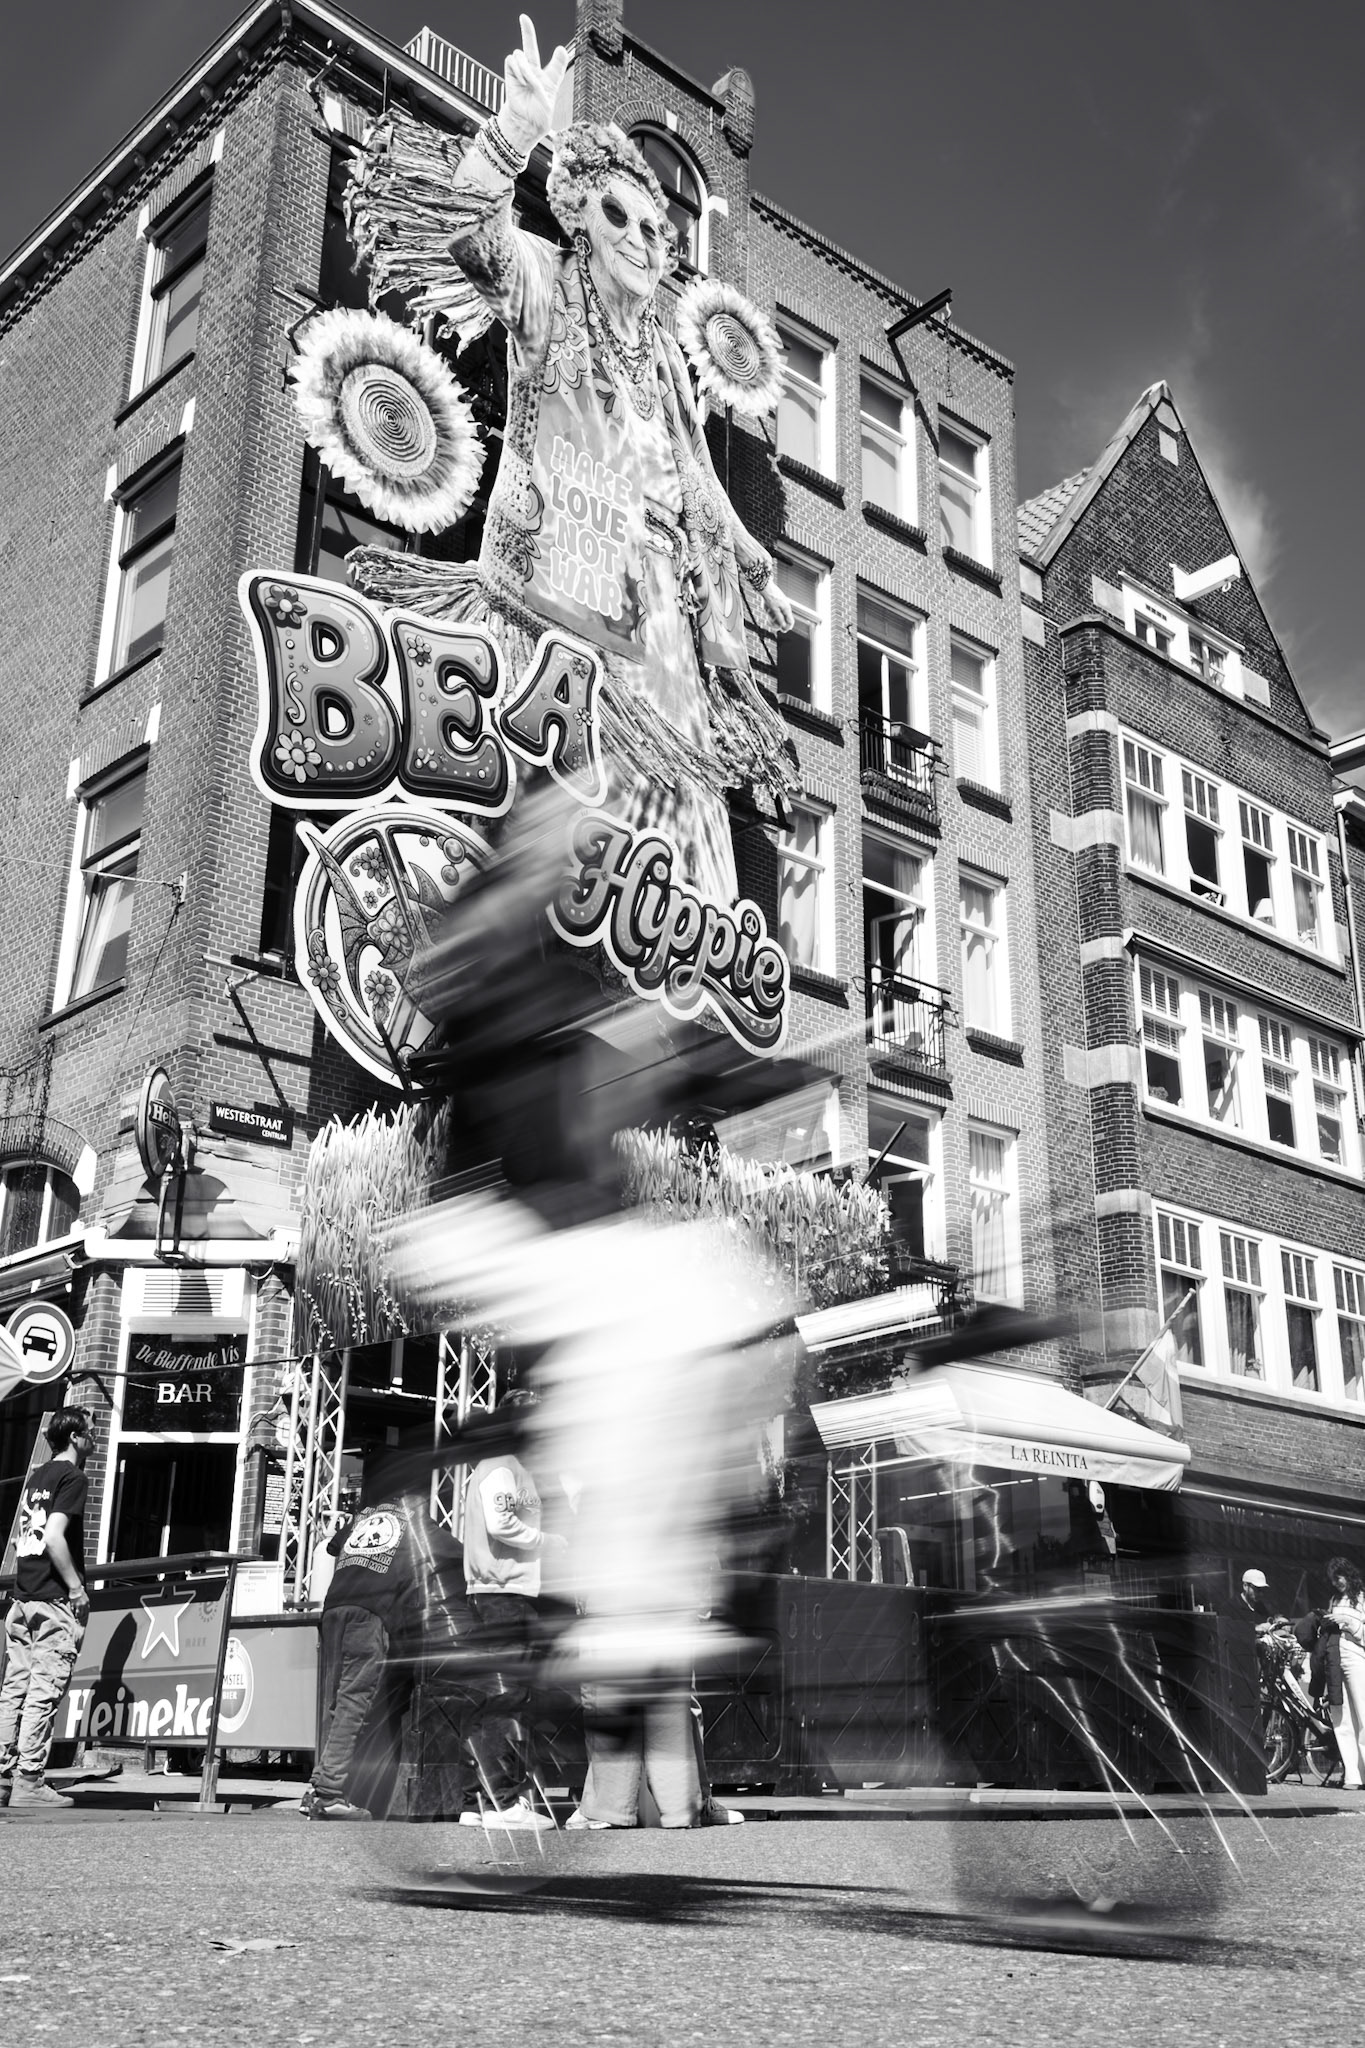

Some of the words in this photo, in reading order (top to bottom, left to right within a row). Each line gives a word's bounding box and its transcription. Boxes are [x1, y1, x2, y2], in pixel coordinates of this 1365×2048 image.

[551, 435, 632, 508] MAKE
[551, 473, 628, 544] LOVE
[555, 514, 620, 576] NOT
[550, 547, 622, 621] WAR
[243, 572, 602, 813] BEA
[548, 812, 788, 1050] Hippie
[216, 1105, 283, 1131] WESTERSTRAAT
[262, 1129, 287, 1141] CENTRUM
[135, 1344, 156, 1363] De
[153, 1350, 218, 1371] Blaffende
[221, 1345, 240, 1364] Vis
[157, 1383, 212, 1403] BAR
[1011, 1445, 1028, 1461] LA
[1032, 1448, 1088, 1469] REINITA
[223, 1673, 244, 1685] MSTEL
